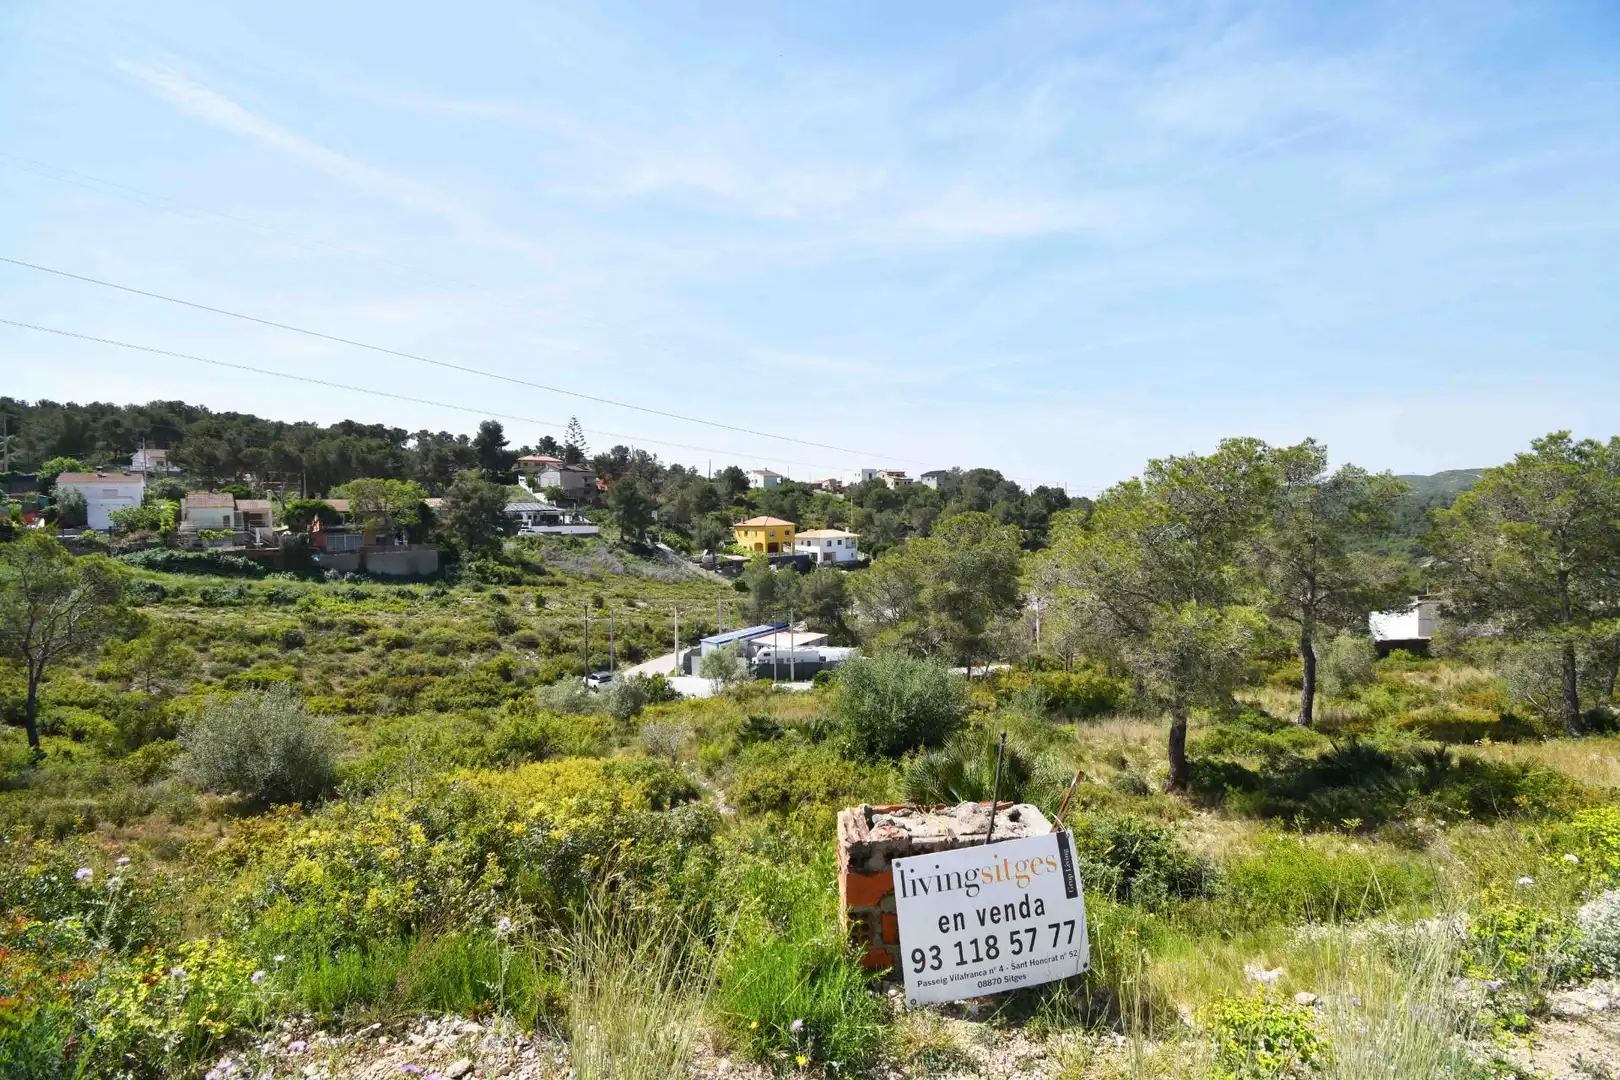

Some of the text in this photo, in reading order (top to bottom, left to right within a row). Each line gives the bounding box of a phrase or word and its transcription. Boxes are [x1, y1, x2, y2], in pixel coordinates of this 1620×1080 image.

[938, 893, 1046, 934] en venda
[911, 920, 1076, 974] 93 118 57 77
[917, 976, 948, 988] Passeig
[949, 969, 988, 982] Vilafranca
[1010, 961, 1028, 971] Sant
[1029, 954, 1059, 967] Honorat
[1069, 949, 1078, 958] 52
[977, 974, 1027, 989] 08870 Sitges
